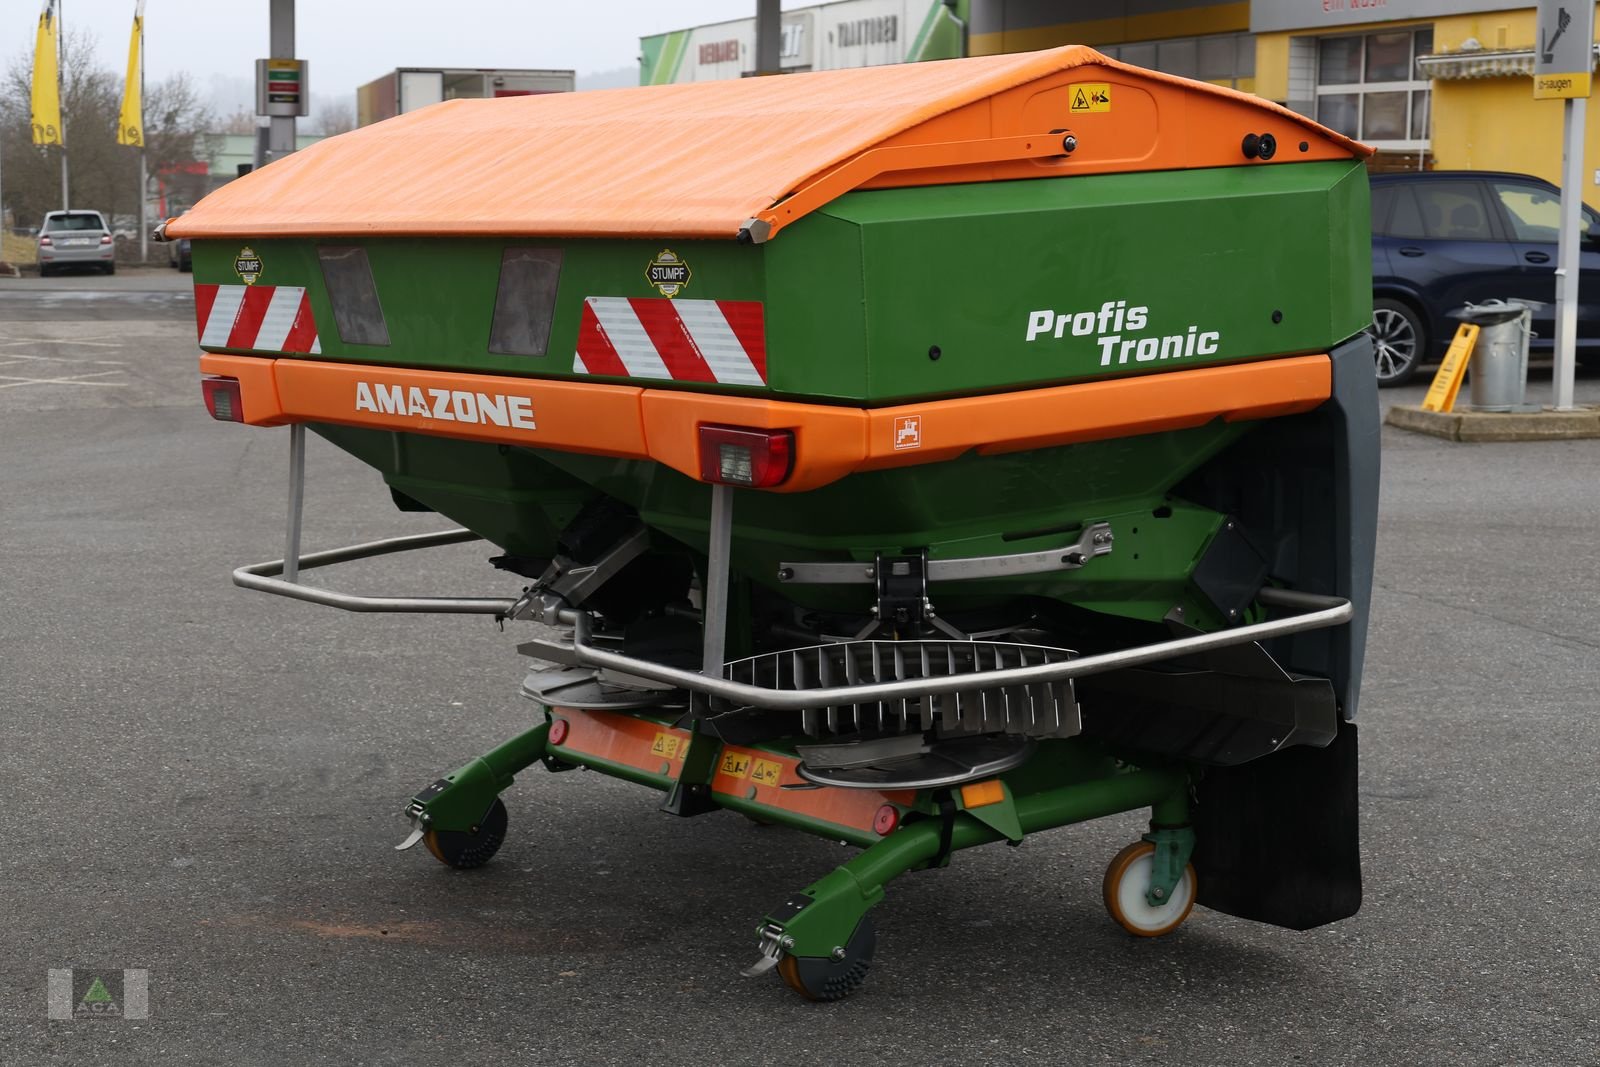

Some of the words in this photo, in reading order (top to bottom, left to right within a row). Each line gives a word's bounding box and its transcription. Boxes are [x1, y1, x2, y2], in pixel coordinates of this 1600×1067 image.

[237, 260, 259, 271] STUMPF
[651, 267, 685, 280] STUMPF
[1025, 300, 1149, 342] Profis
[1097, 325, 1220, 366] Tronic
[355, 381, 537, 430] AMAZONE
